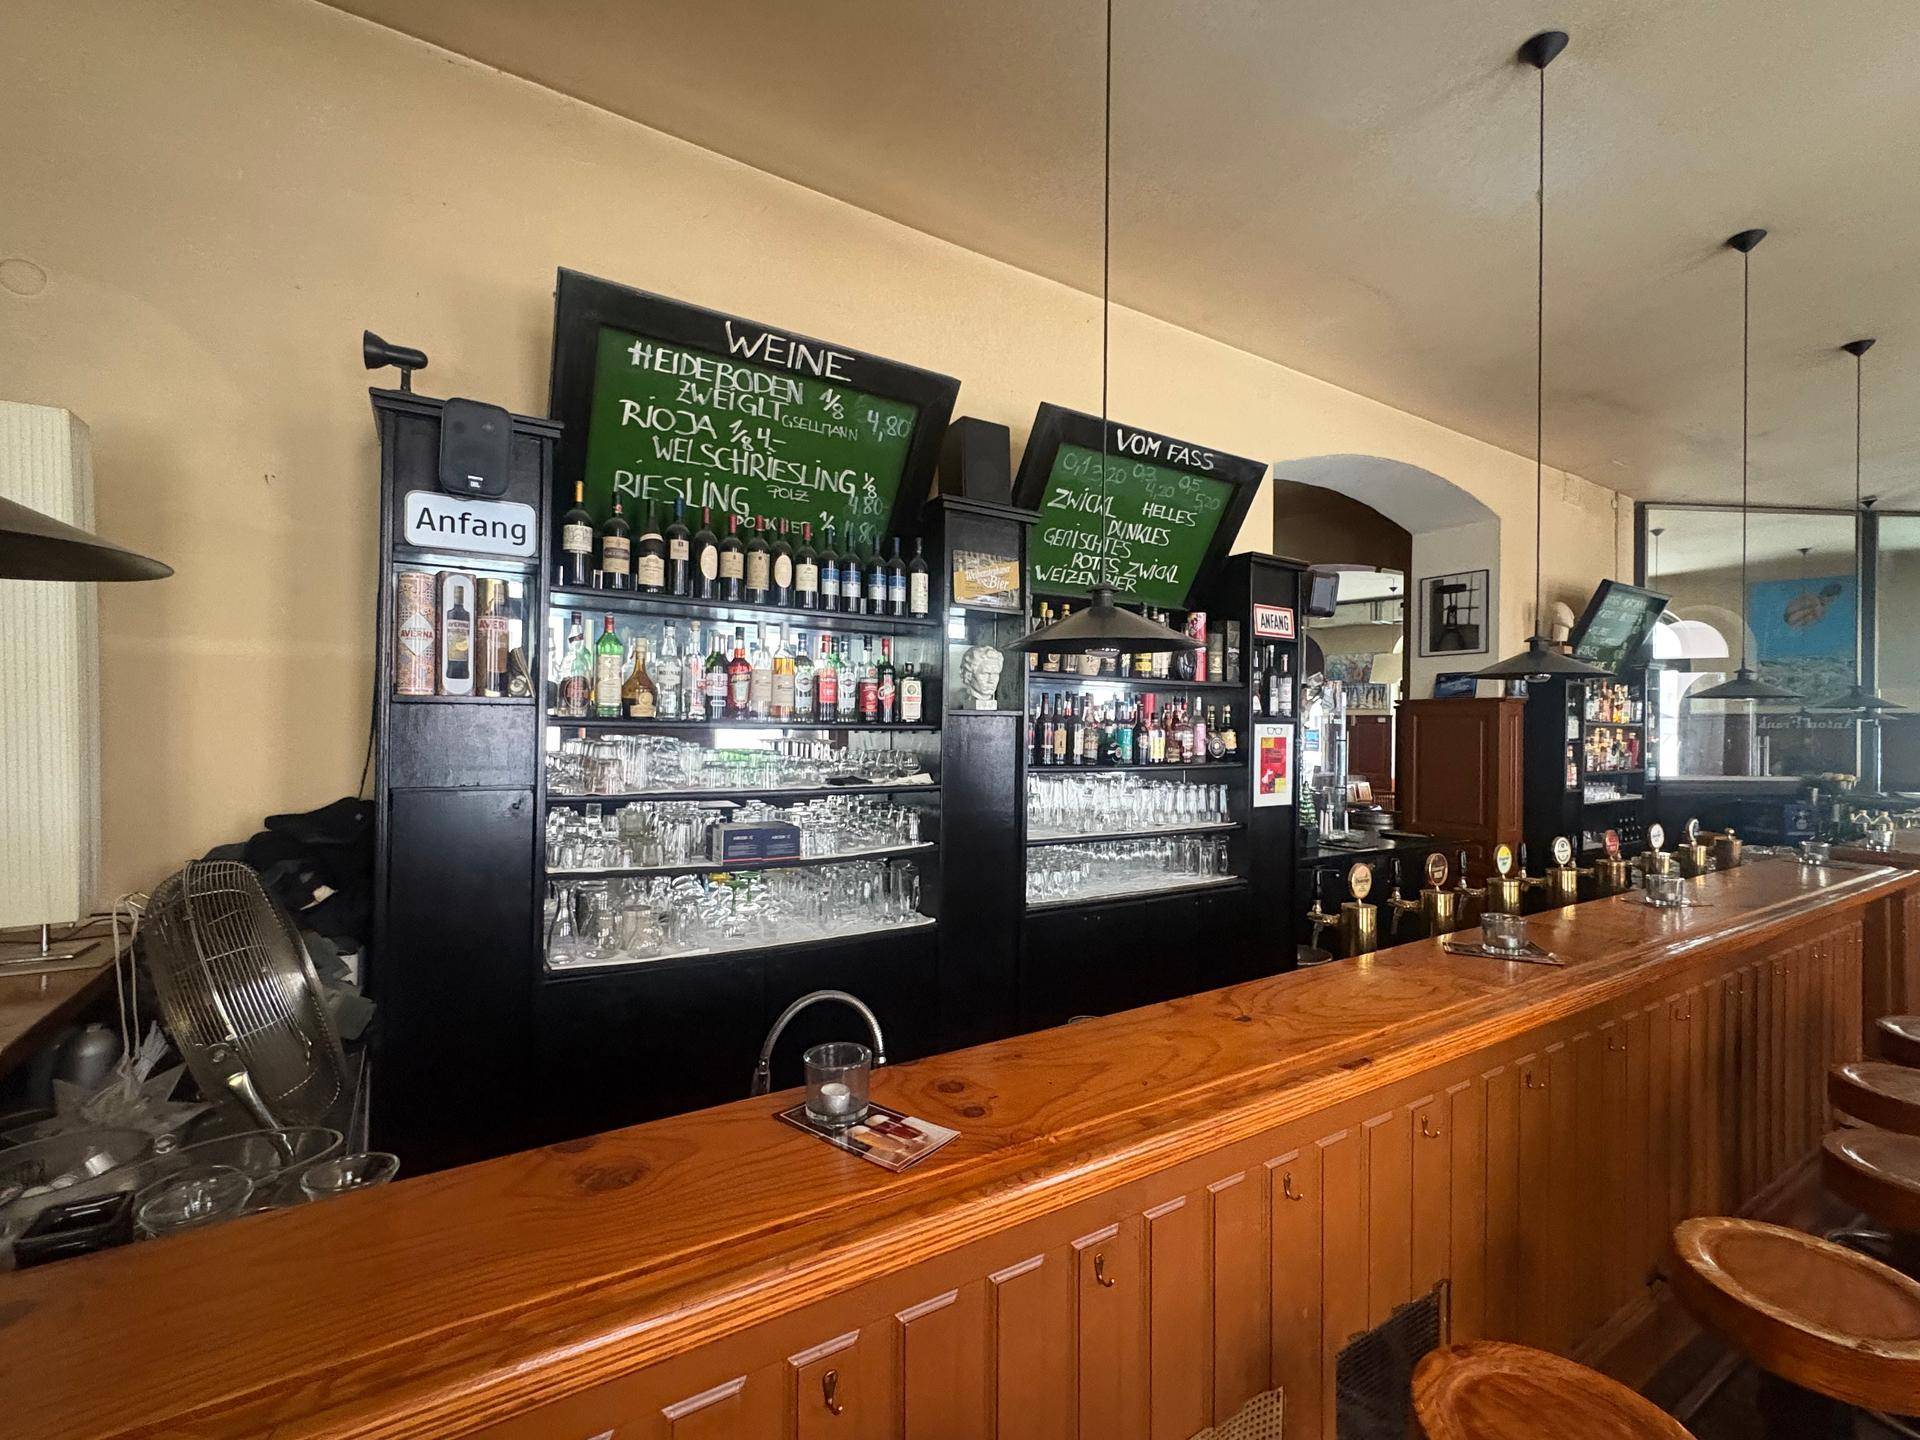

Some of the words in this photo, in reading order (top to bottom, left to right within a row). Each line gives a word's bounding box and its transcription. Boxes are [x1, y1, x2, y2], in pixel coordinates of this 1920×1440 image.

[725, 320, 855, 382] WEINE
[627, 339, 804, 405] HEIDEBODEN
[820, 388, 845, 421] 1/8
[867, 409, 912, 442] 4,80
[676, 379, 790, 421] ZWEIGLT
[618, 395, 717, 439] RIOJA
[728, 419, 754, 452] 1/8
[652, 434, 857, 497] WELSCHRIESLING
[1117, 429, 1162, 458] VOM
[1167, 444, 1214, 471] FASS
[613, 460, 751, 517] RIESLING
[416, 507, 527, 546] Anfang
[1107, 520, 1172, 547] DUNKLES
[1142, 501, 1198, 528] HELLES
[1260, 612, 1289, 632] ANFANG
